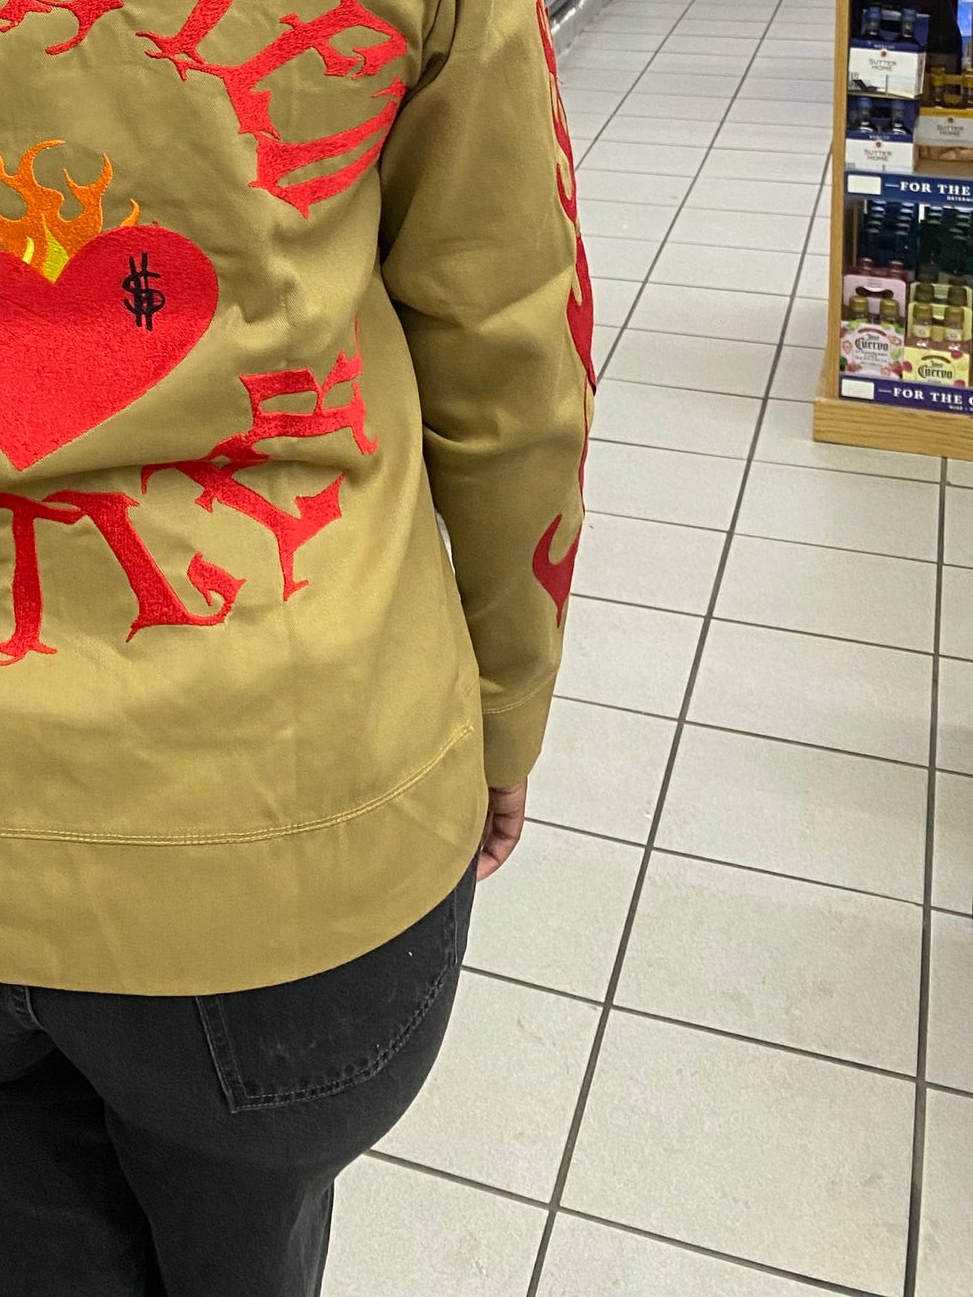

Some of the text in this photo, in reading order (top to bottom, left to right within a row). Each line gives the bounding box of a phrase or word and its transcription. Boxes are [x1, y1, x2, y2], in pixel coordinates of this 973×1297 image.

[900, 181, 971, 196] FOR THE
[855, 338, 889, 352] Cuervo
[918, 364, 953, 380] Cuervo
[893, 387, 963, 405] FOR THE
